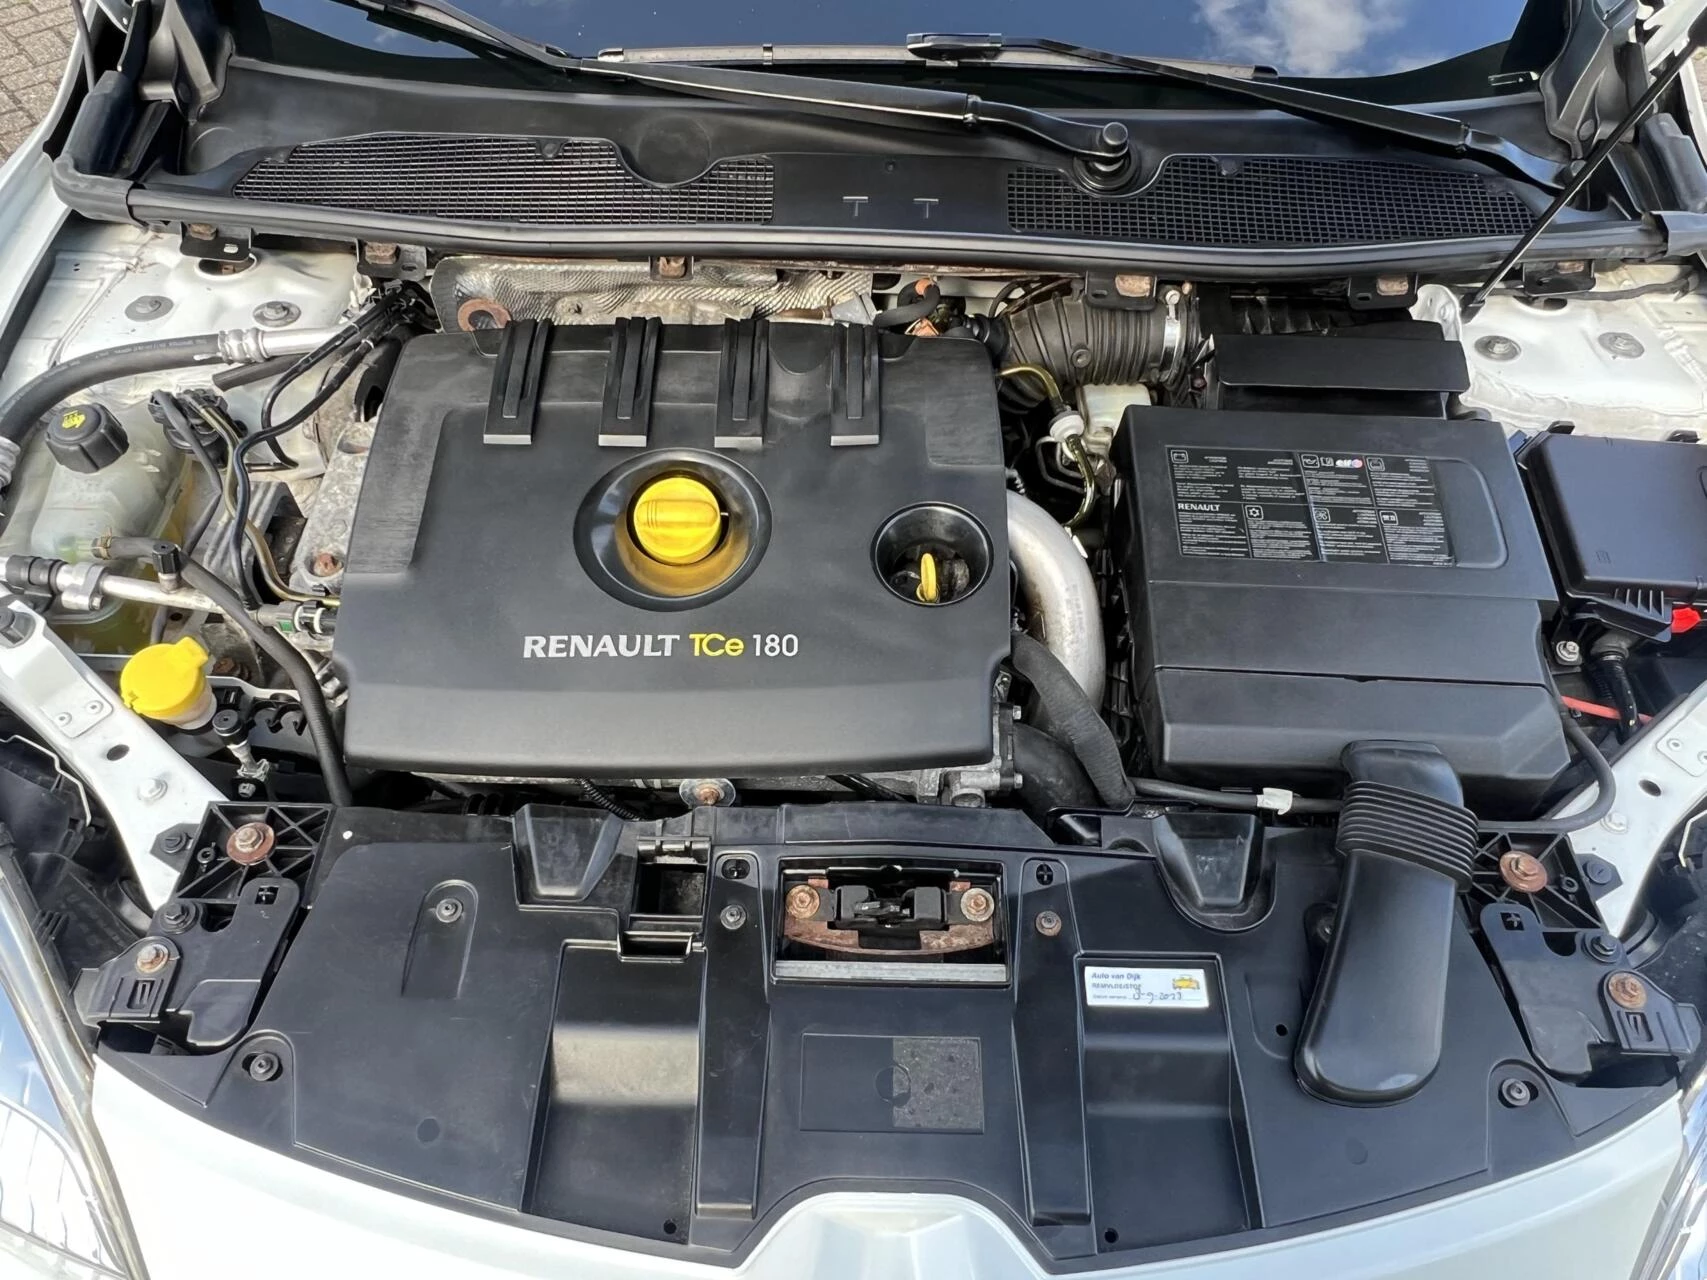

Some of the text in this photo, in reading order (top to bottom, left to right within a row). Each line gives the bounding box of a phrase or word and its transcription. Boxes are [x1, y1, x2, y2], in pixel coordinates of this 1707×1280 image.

[1177, 503, 1220, 512] RENAULT
[523, 633, 799, 658] RENAULT TCe 180
[1091, 972, 1110, 980] Auto
[1126, 972, 1141, 981] Dijk
